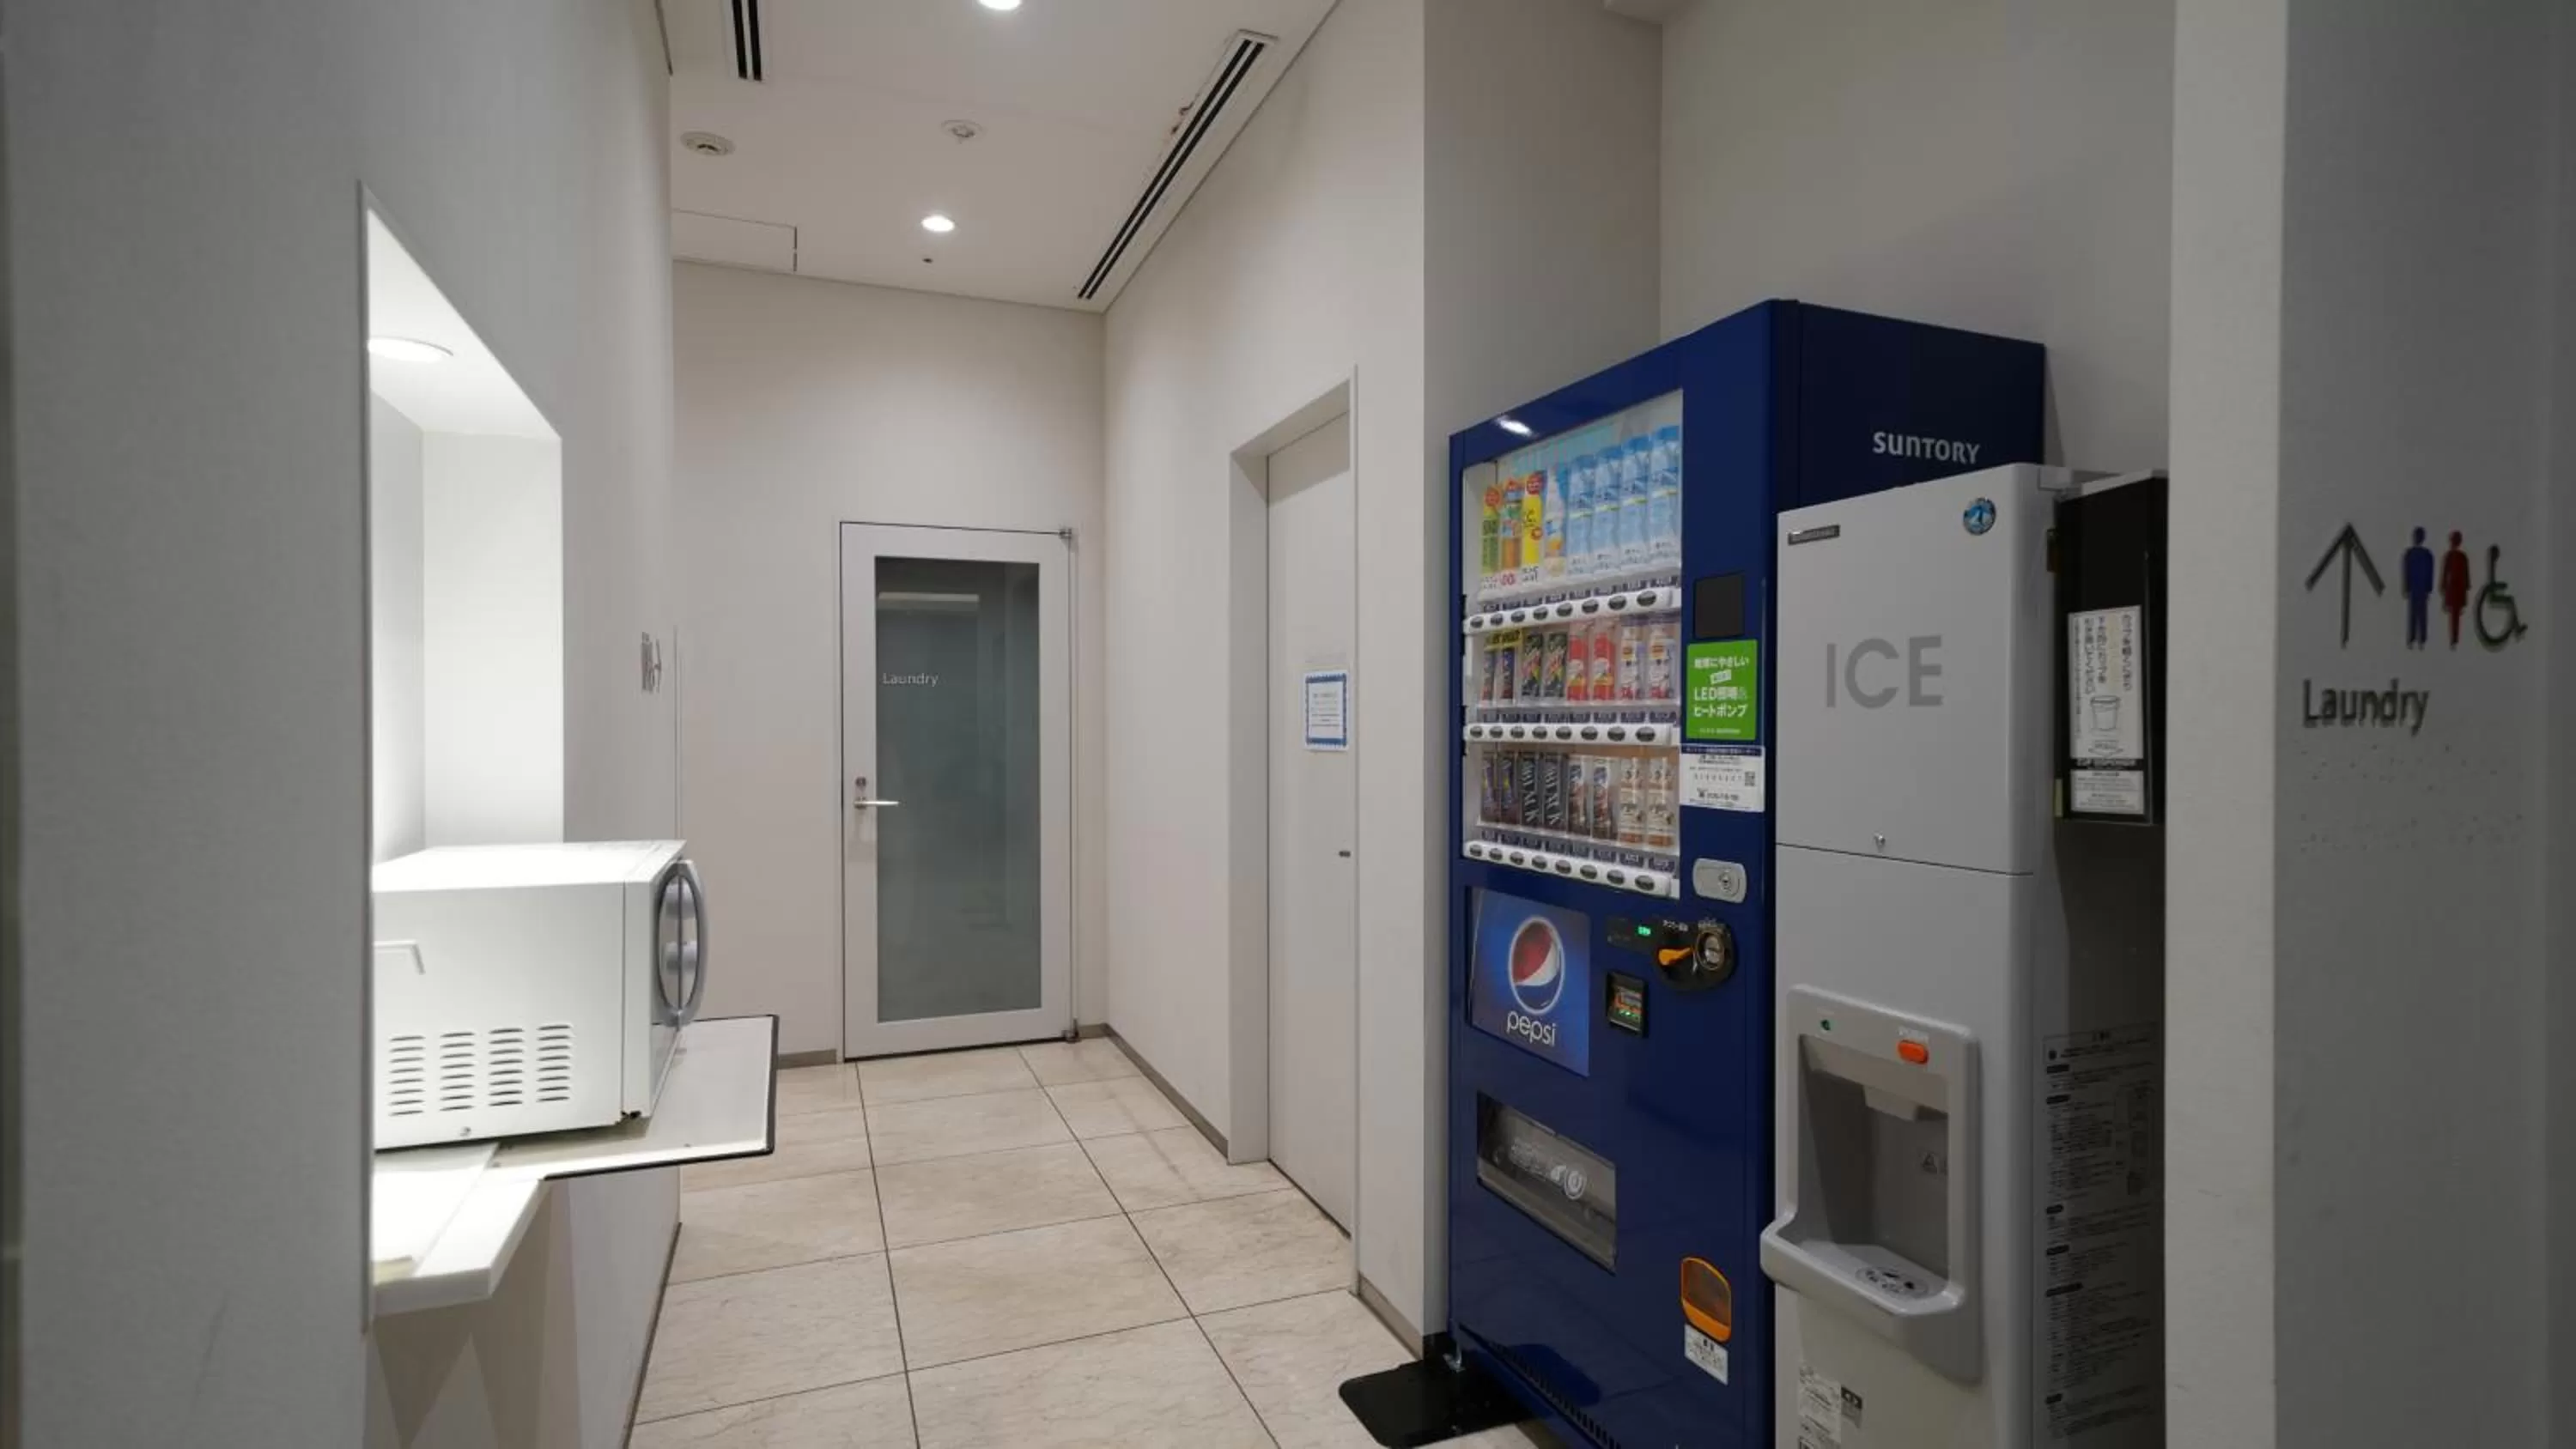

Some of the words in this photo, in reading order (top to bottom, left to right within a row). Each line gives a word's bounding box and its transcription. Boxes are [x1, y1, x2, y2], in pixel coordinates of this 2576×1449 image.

[1873, 431, 1980, 464] SUNTORY
[884, 672, 939, 688] Laundry
[1826, 635, 1944, 709] ICE
[2303, 678, 2429, 737] Laundry
[1507, 1011, 1555, 1046] pepsi
